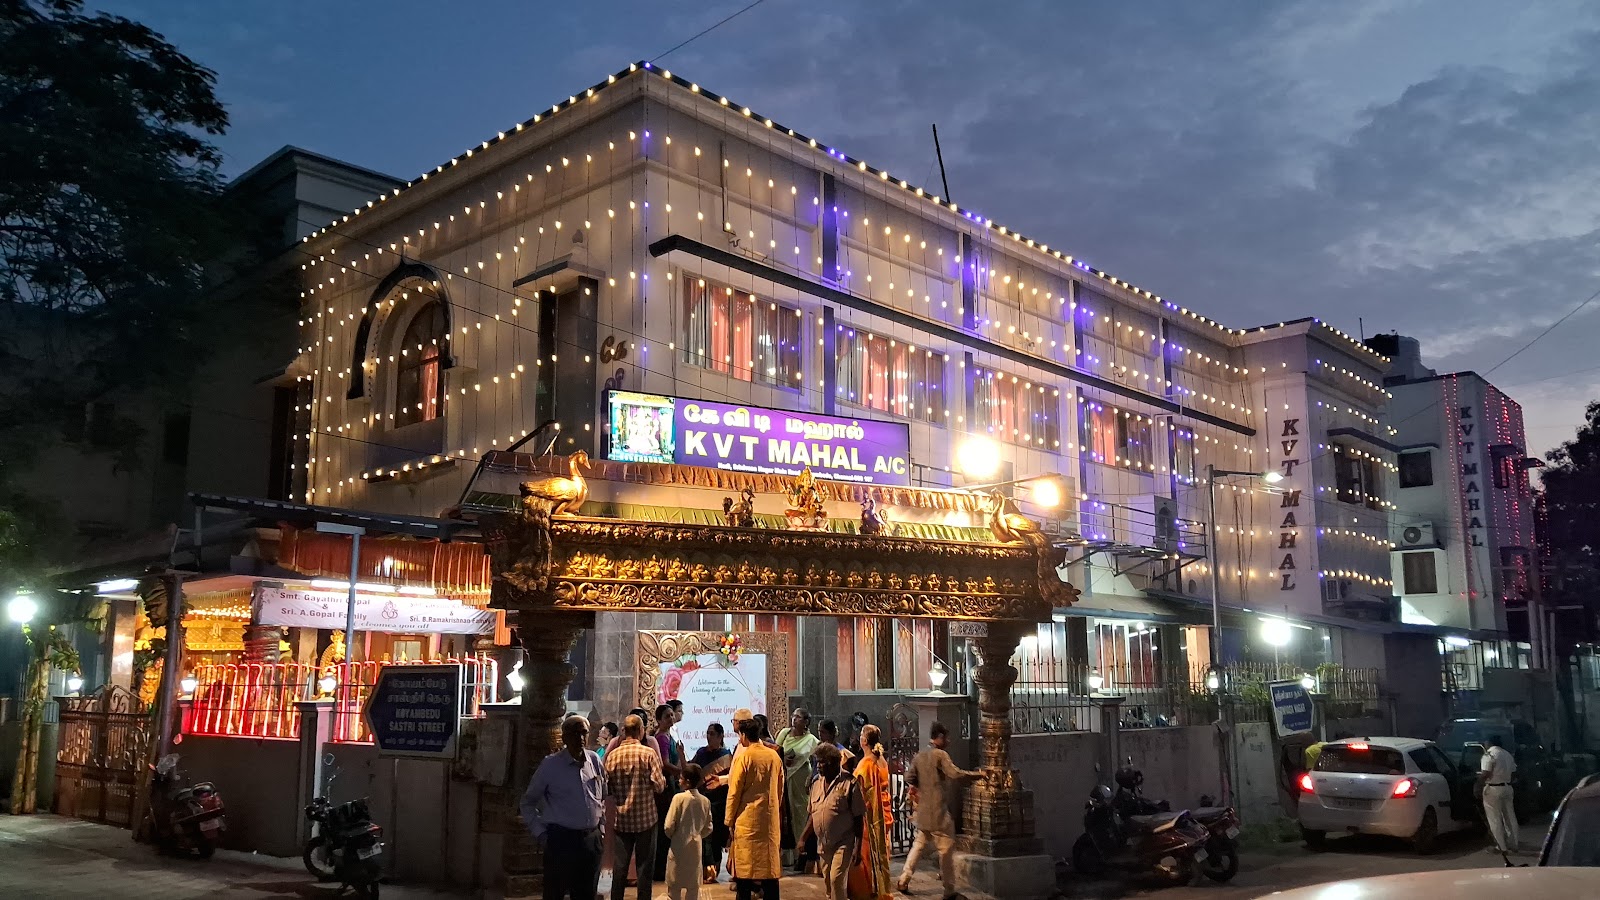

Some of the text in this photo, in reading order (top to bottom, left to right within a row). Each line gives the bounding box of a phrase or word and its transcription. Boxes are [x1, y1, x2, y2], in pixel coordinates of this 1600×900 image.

[768, 438, 867, 471] MAHAL
[873, 455, 906, 475] A/C
[1463, 463, 1483, 547] MAHAL
[1278, 490, 1302, 591] MAHAL
[280, 592, 301, 601] Smt.
[345, 598, 371, 606] Gpal
[281, 607, 297, 616] Sri.
[299, 609, 336, 620] A.Gopal
[409, 615, 420, 623] Sri.
[692, 686, 710, 695] Wedding
[389, 721, 446, 732] SASTRI STREET
